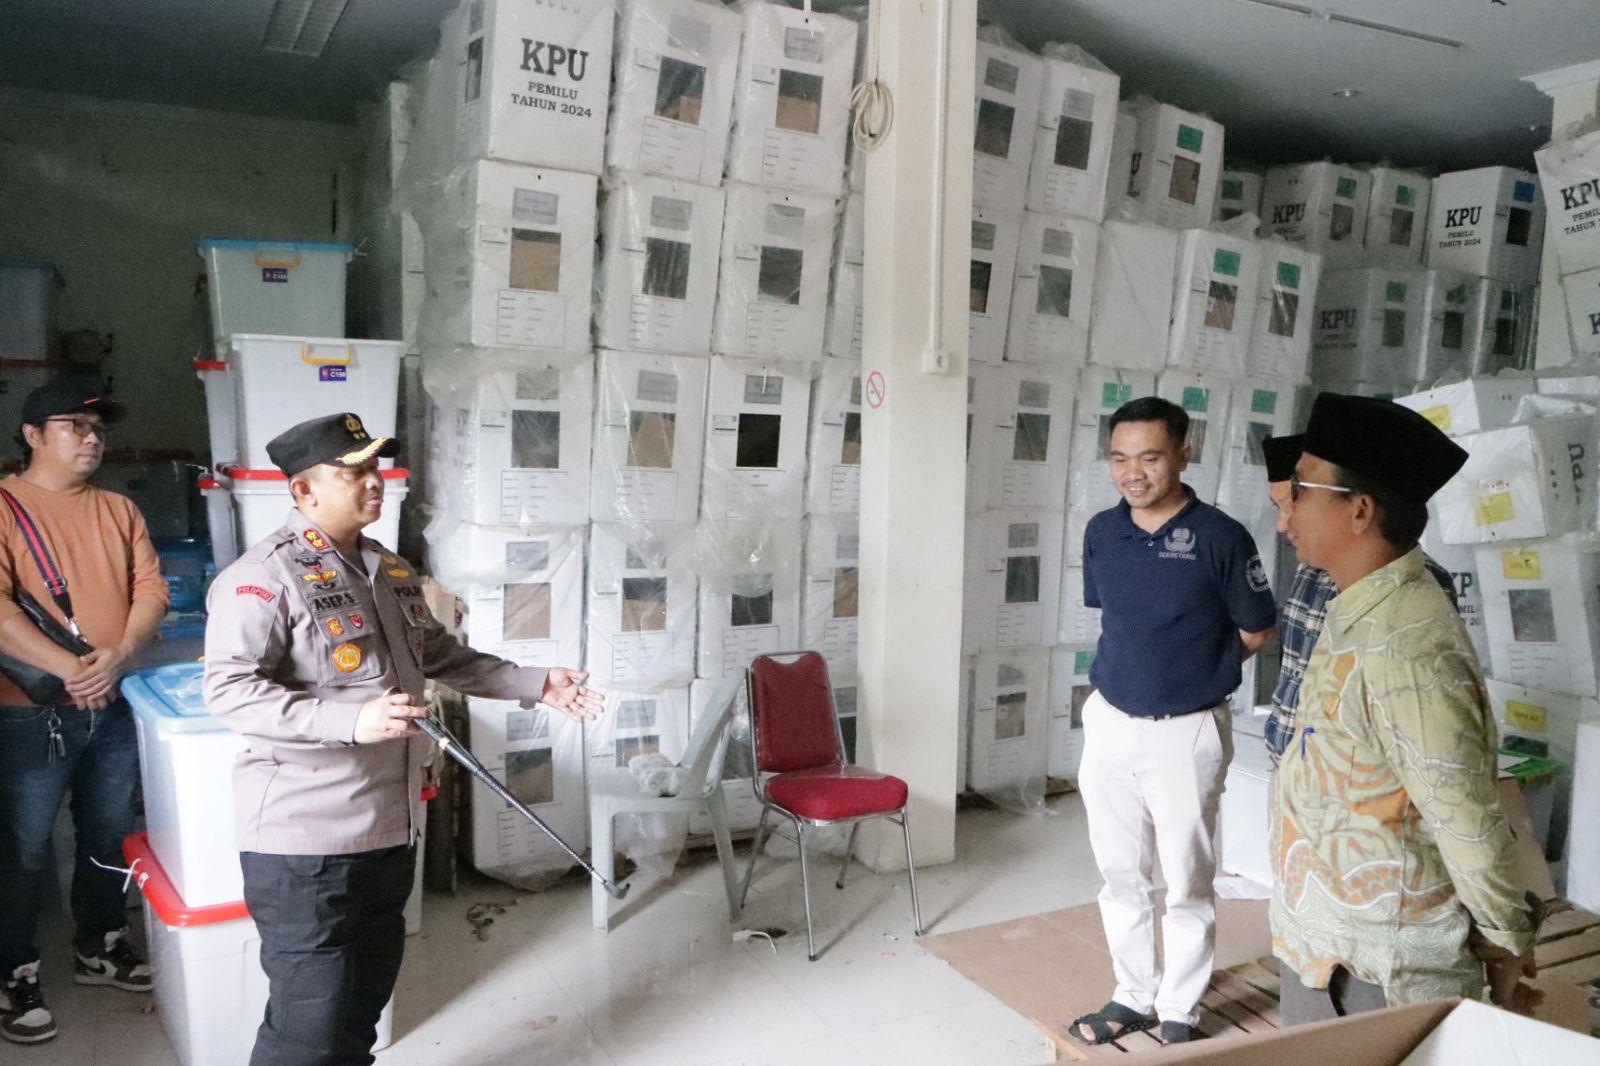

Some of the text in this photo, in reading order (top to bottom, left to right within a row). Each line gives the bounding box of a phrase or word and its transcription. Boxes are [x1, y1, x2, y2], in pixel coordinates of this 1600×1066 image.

[521, 37, 589, 81] KPU
[528, 81, 578, 100] PEMILU
[510, 93, 592, 118] TAHUN 2024
[1272, 202, 1307, 225] KPU
[1445, 206, 1482, 228] KPU
[1319, 309, 1357, 330] KPU
